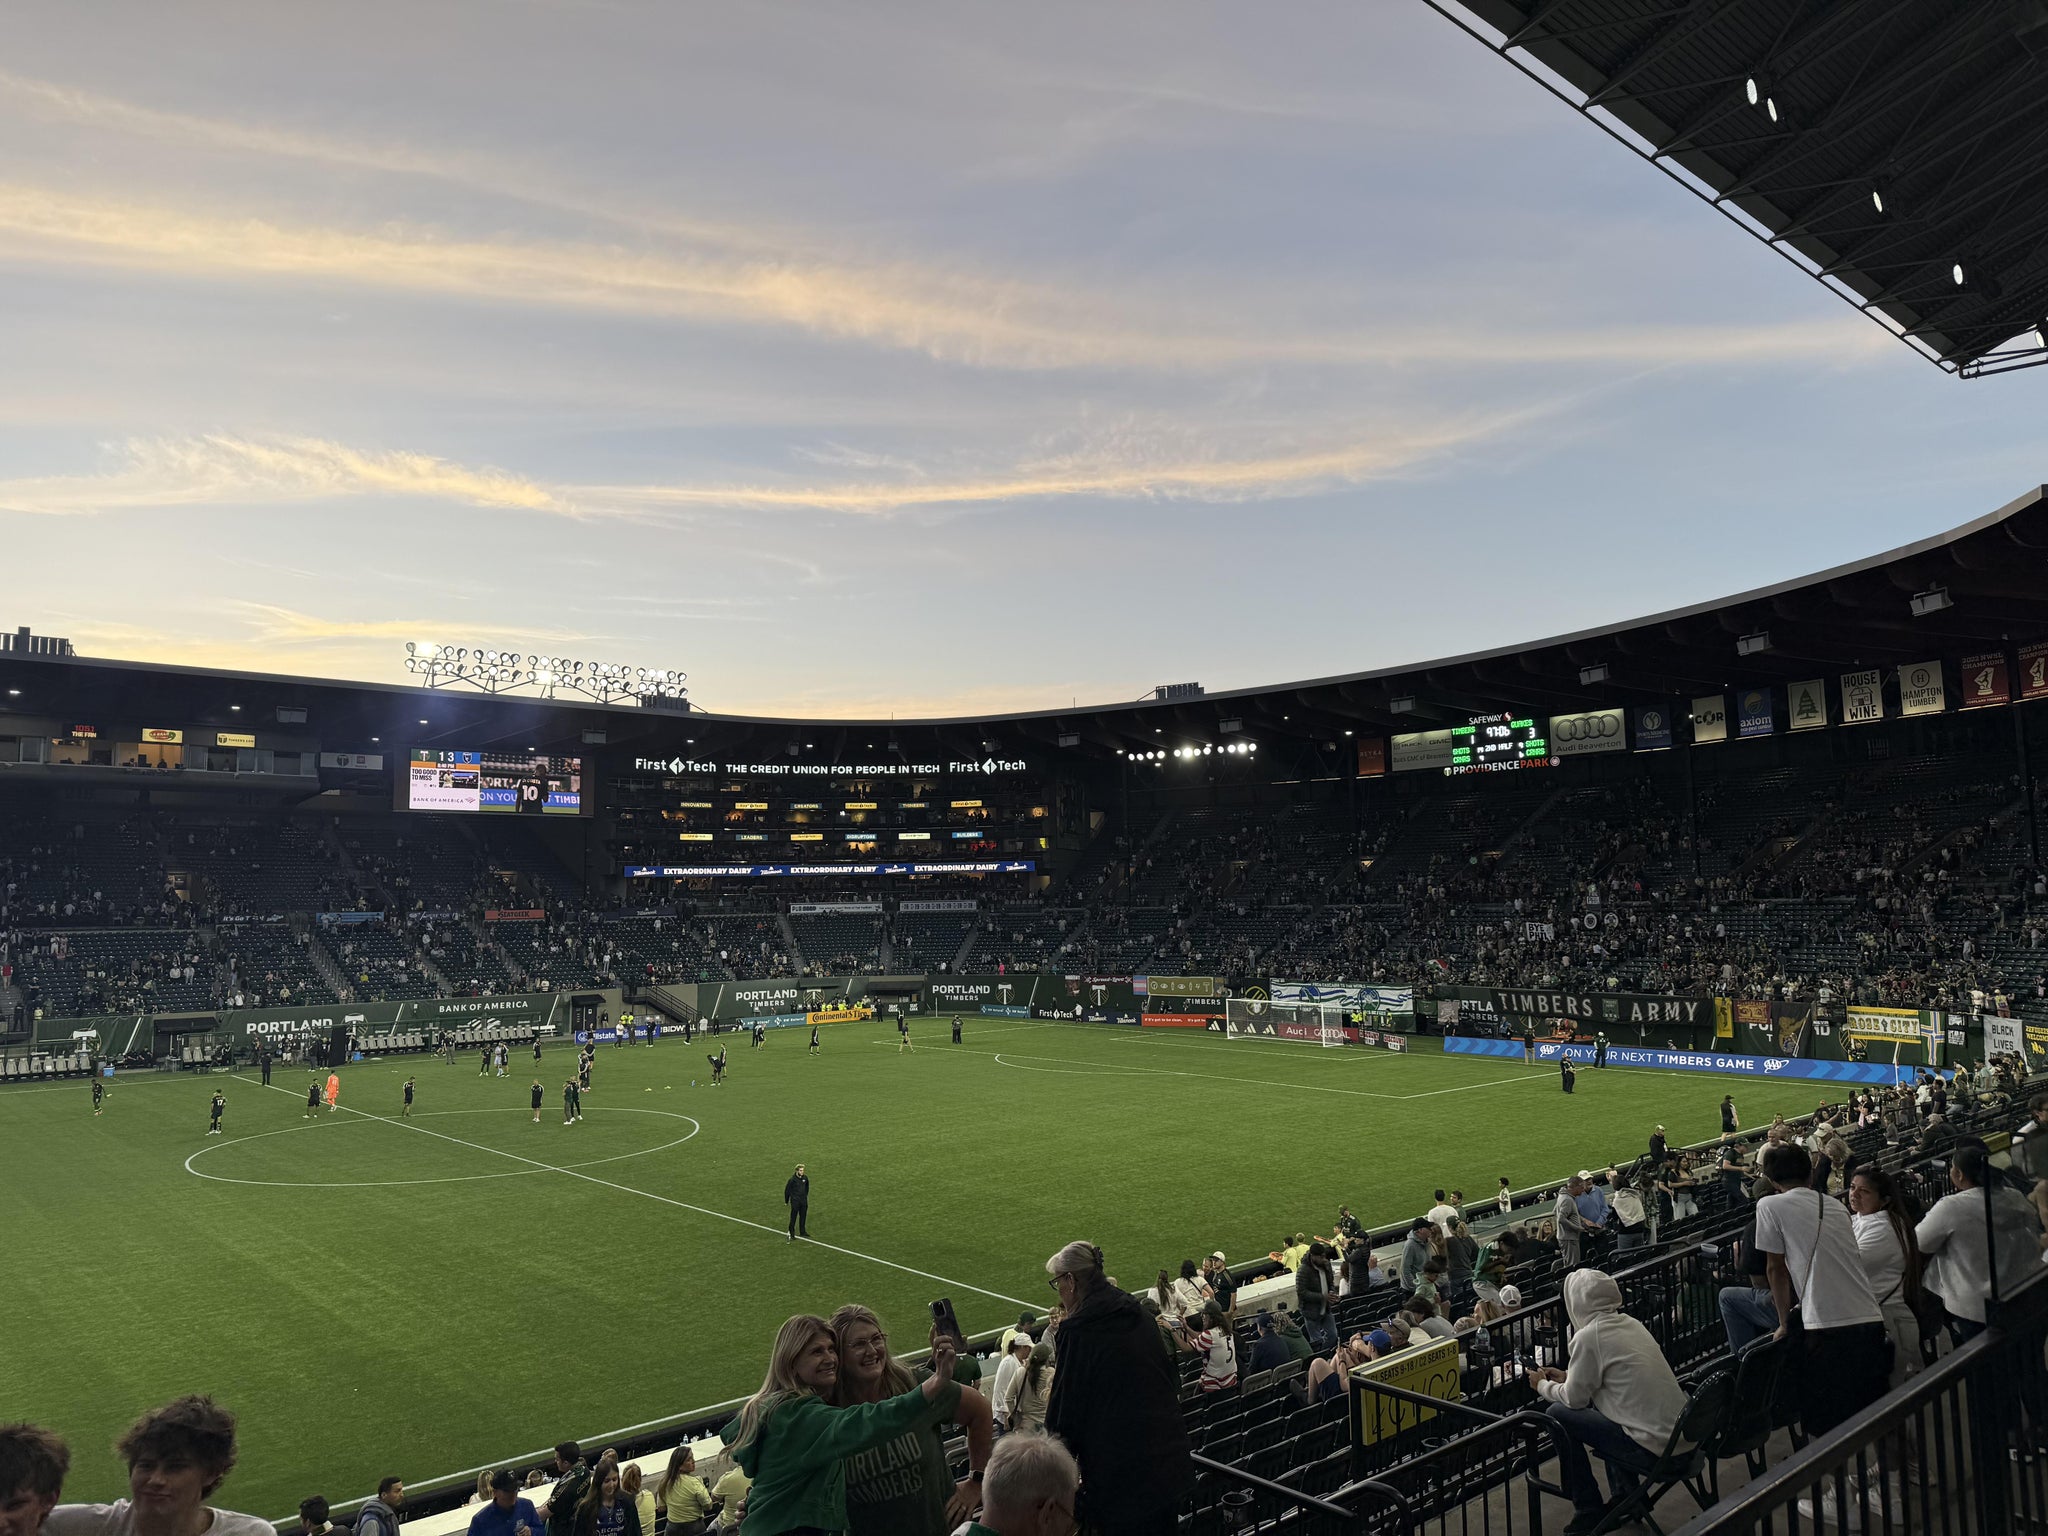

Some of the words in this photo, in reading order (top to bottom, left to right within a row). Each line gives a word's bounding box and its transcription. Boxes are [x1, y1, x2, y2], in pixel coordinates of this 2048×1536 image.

[1962, 658, 2004, 669] CHAMPIONS
[1844, 672, 1876, 688] HOUSE
[1902, 686, 1942, 700] HAMPTON
[1910, 696, 1937, 708] LUMBER
[1850, 704, 1877, 720] WINE
[1468, 714, 1502, 725] SAFEWAY
[1740, 716, 1772, 728] axiom
[1452, 726, 1476, 735] TIMBERS
[1528, 728, 1536, 738] 3
[1498, 742, 1514, 750] HALF
[1525, 739, 1544, 748] SHOTS
[1556, 744, 1576, 752] Audi
[1578, 740, 1622, 750] Beaverton
[438, 752, 444, 761] 1
[448, 752, 454, 762] 3
[1452, 747, 1470, 756] SHOTS
[635, 758, 666, 771] First
[686, 760, 716, 772] Tech
[726, 764, 748, 773] THE
[750, 764, 790, 774] CREDIT
[793, 766, 828, 774] UNION
[831, 766, 852, 774] FOR
[856, 766, 896, 774] PEOPLE
[898, 766, 910, 774] IN
[912, 765, 940, 774] TECH
[950, 762, 980, 772] First
[998, 760, 1026, 771] Tech
[480, 792, 494, 801] ON
[522, 785, 539, 800] 10
[1528, 924, 1545, 932] BYE
[1530, 932, 1548, 940] PHIL
[736, 989, 798, 1001] PORTLAND
[932, 985, 990, 994] PORTLAND
[439, 1004, 467, 1013] BANK
[470, 1002, 482, 1011] OF
[484, 1000, 528, 1010] AMERICA
[1498, 992, 1593, 1017] TIMBERS
[1631, 1002, 1698, 1022] ARMY
[812, 1010, 848, 1022] Continental
[1039, 1009, 1052, 1017] First
[1060, 1010, 1074, 1018] Tech
[246, 1018, 333, 1034] PORTLAND
[662, 1024, 697, 1033] BIDWLL
[1850, 1016, 1880, 1030] ROSE
[1890, 1020, 1918, 1034] CITY
[1992, 1024, 2014, 1036] BLACK
[1994, 1039, 2014, 1050] LIVES
[1565, 1048, 1582, 1058] ON
[1621, 1051, 1654, 1062] NEXT
[1657, 1054, 1712, 1067] TIMBERS
[1716, 1058, 1754, 1070] GAME
[1226, 1336, 1233, 1364] 5
[1380, 1367, 1400, 1382] SEATS
[1400, 1362, 1414, 1374] 9-18
[1420, 1356, 1426, 1367] C2
[1428, 1352, 1446, 1364] SEATS
[1447, 1345, 1456, 1356] 1-8
[845, 1432, 922, 1484] ORTLAND
